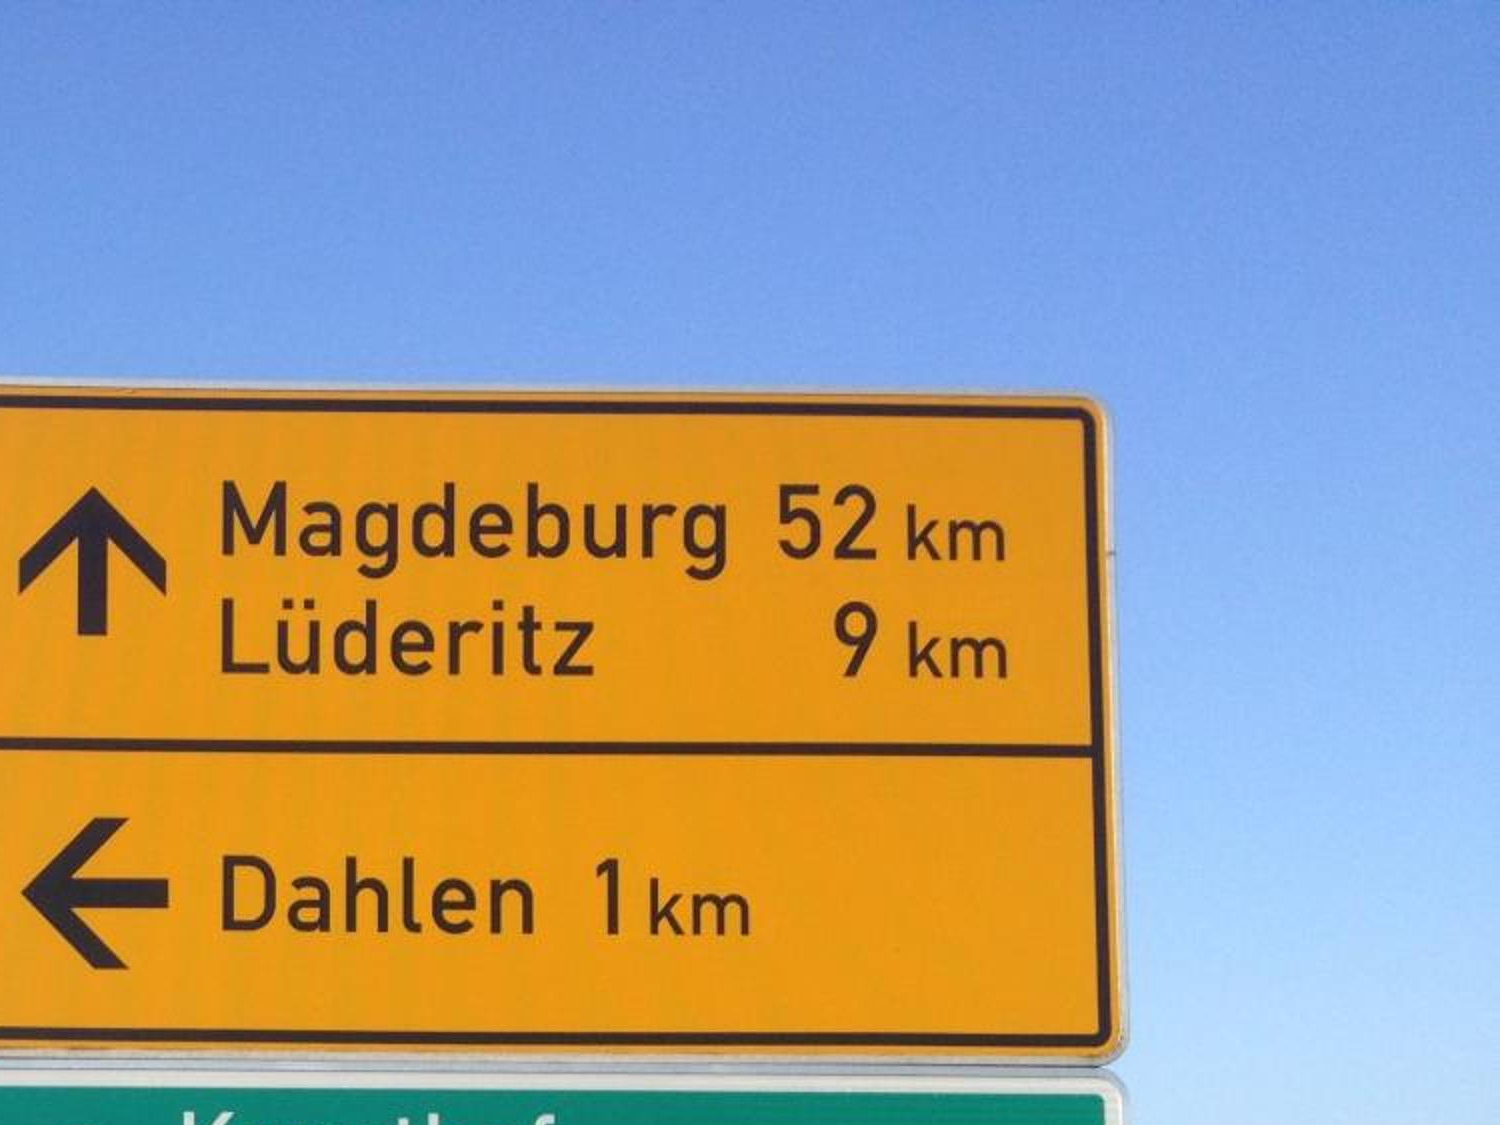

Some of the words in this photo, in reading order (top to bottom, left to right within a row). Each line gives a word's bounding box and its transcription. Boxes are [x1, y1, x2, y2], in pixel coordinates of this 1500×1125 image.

[221, 478, 728, 582] Magdeburg
[778, 482, 878, 562] 52
[906, 503, 1006, 563] km
[220, 597, 595, 677] Lüderitz
[833, 600, 879, 678] 9
[907, 620, 1008, 680] km
[221, 854, 535, 936] Dahlen
[595, 857, 620, 936] 1
[648, 876, 750, 937] km
